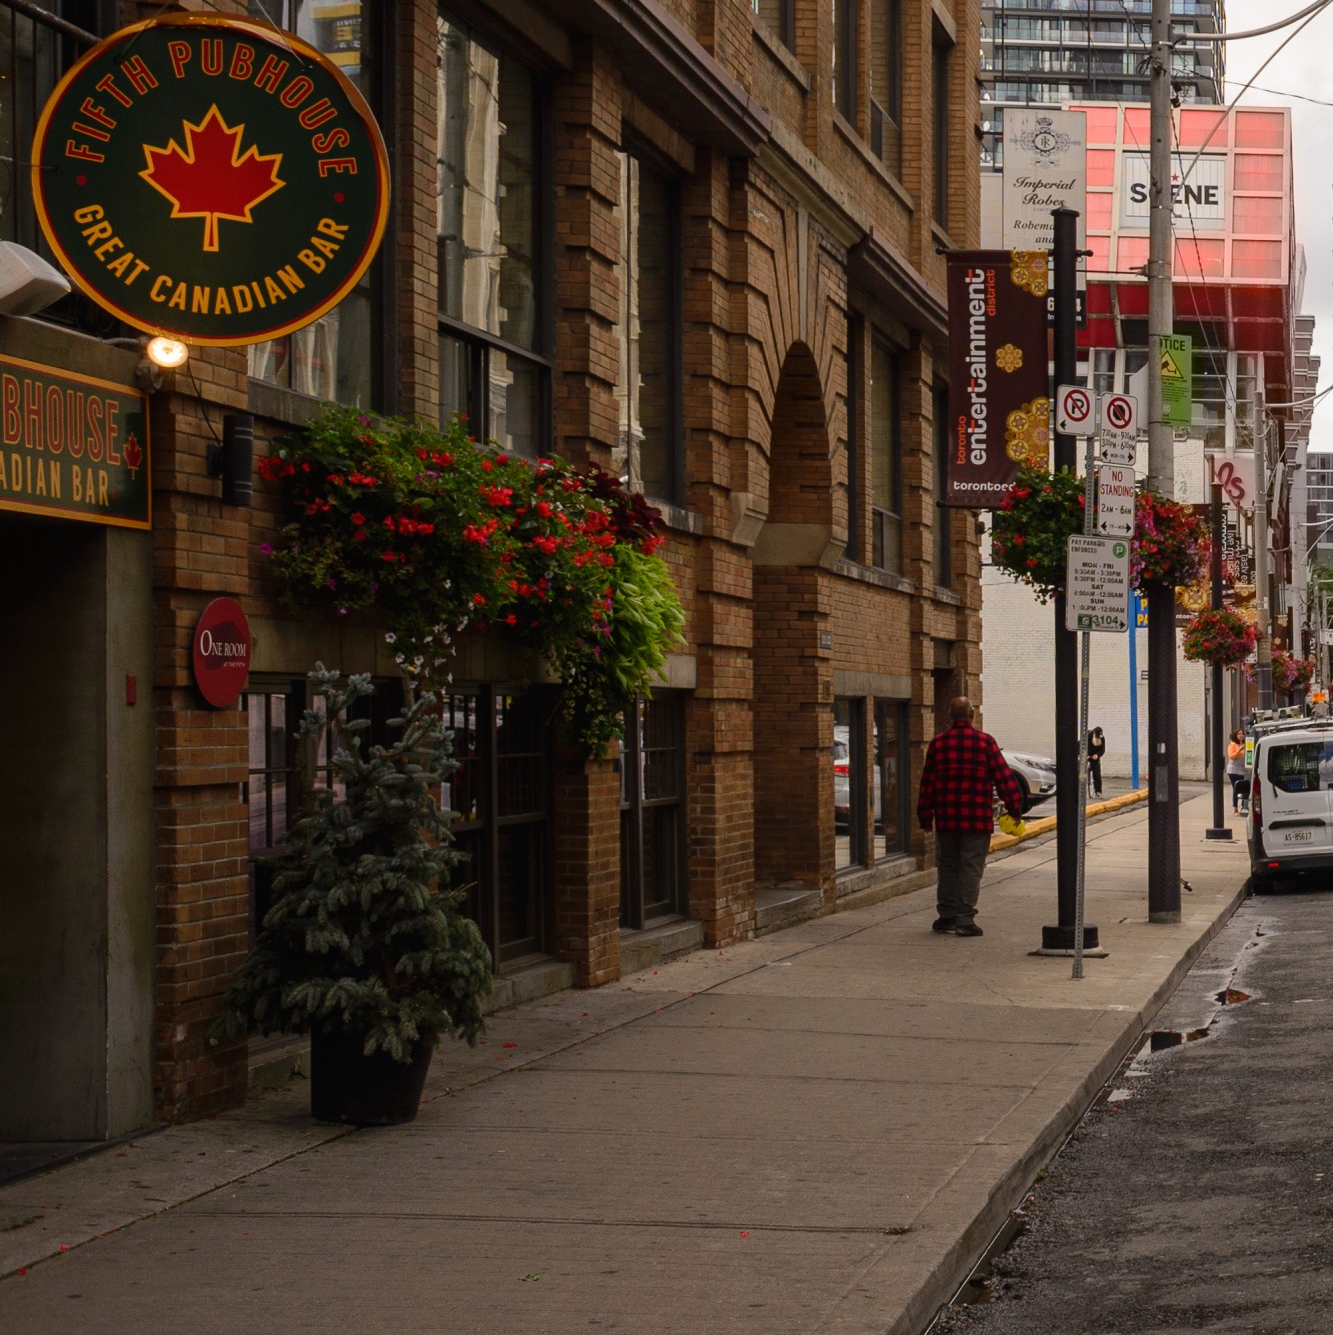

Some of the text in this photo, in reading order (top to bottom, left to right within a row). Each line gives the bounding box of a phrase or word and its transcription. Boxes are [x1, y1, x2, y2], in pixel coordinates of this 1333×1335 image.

[65, 38, 358, 178] FIFTH PUBHOUSE
[1013, 176, 1077, 192] Imperial
[1130, 183, 1219, 206] SENE
[1022, 193, 1067, 207] Robes
[74, 204, 349, 315] GREAT CANADIAN BAR
[986, 269, 996, 317] district
[965, 268, 988, 466] entertainment
[956, 415, 967, 466] toronto
[72, 464, 109, 506] BAR
[1112, 470, 1123, 482] NO
[1100, 485, 1134, 498] STANDING
[1120, 505, 1132, 515] 6AM
[1092, 615, 1119, 625] 3104
[200, 629, 247, 657] ONE ROOM
